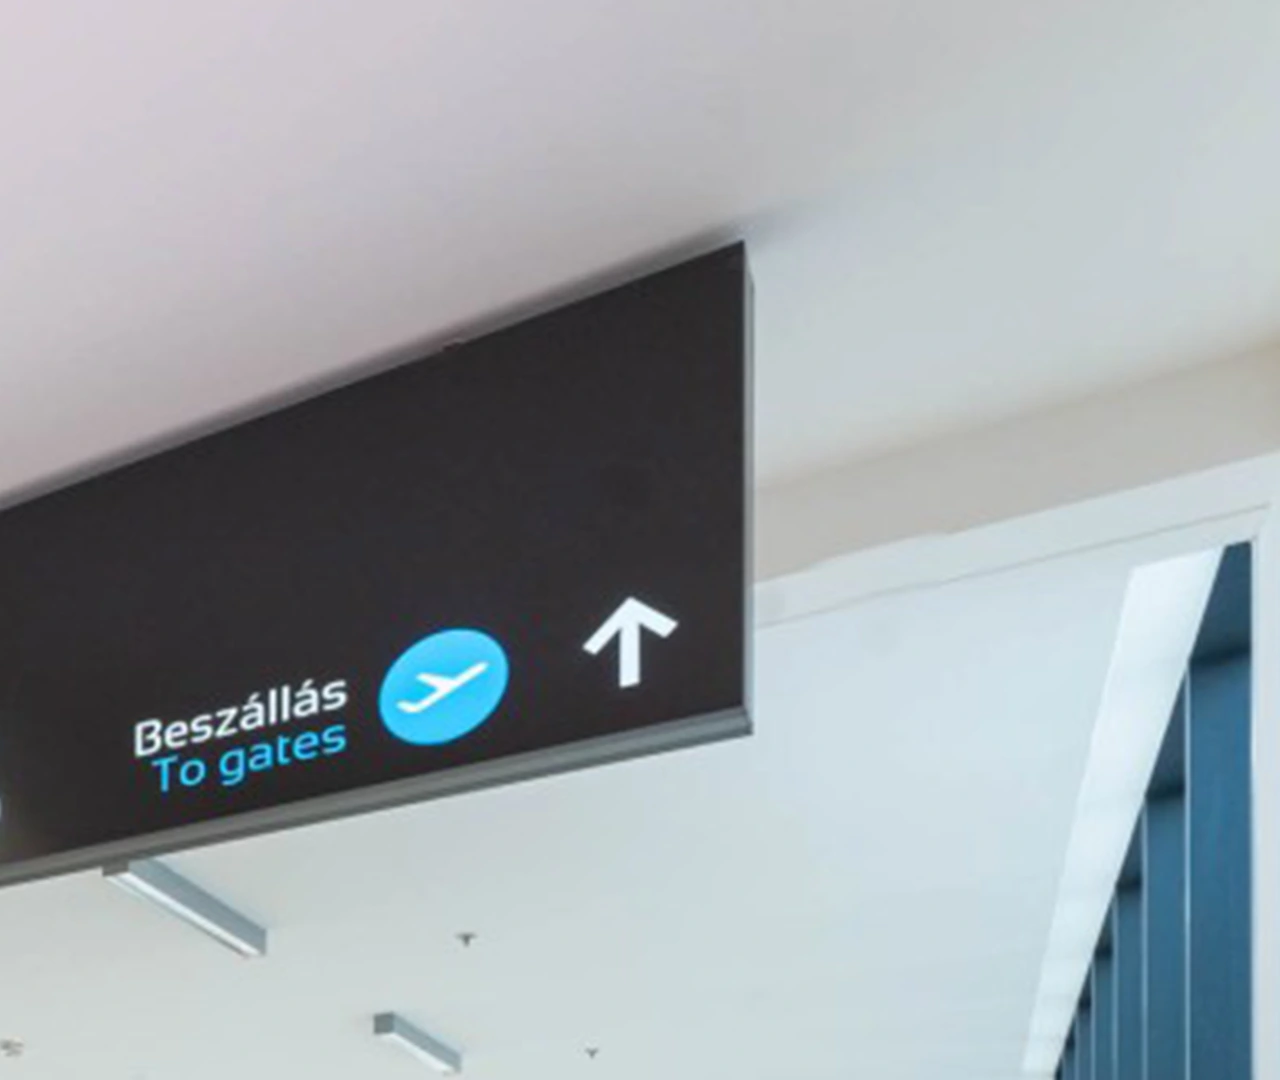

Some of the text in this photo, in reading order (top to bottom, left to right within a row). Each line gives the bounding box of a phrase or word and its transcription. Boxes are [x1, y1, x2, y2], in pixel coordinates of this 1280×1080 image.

[134, 679, 348, 757] Beszállás
[151, 724, 347, 792] To gates
